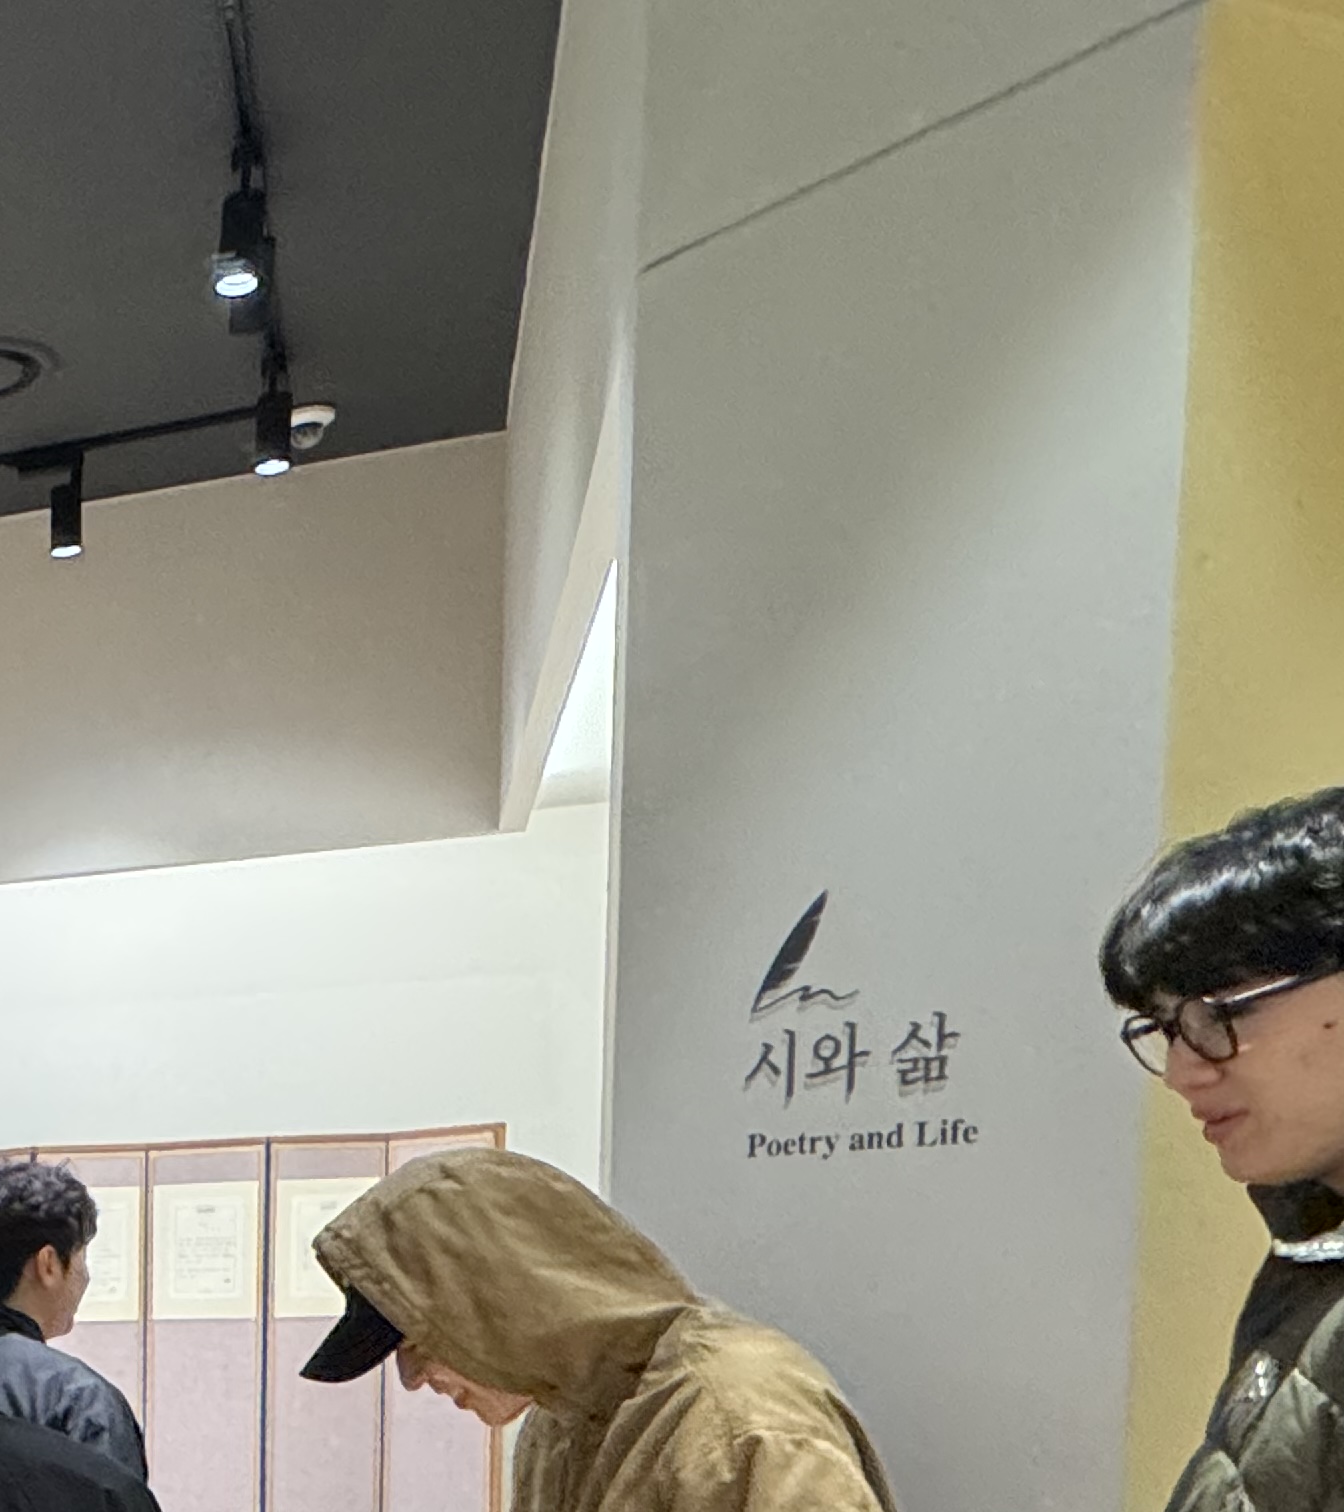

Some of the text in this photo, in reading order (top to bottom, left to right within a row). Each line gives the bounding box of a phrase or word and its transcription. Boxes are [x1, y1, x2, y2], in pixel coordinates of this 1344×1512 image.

[744, 1010, 962, 1101] 시와 삶
[746, 1117, 981, 1161] Poetry and Life
